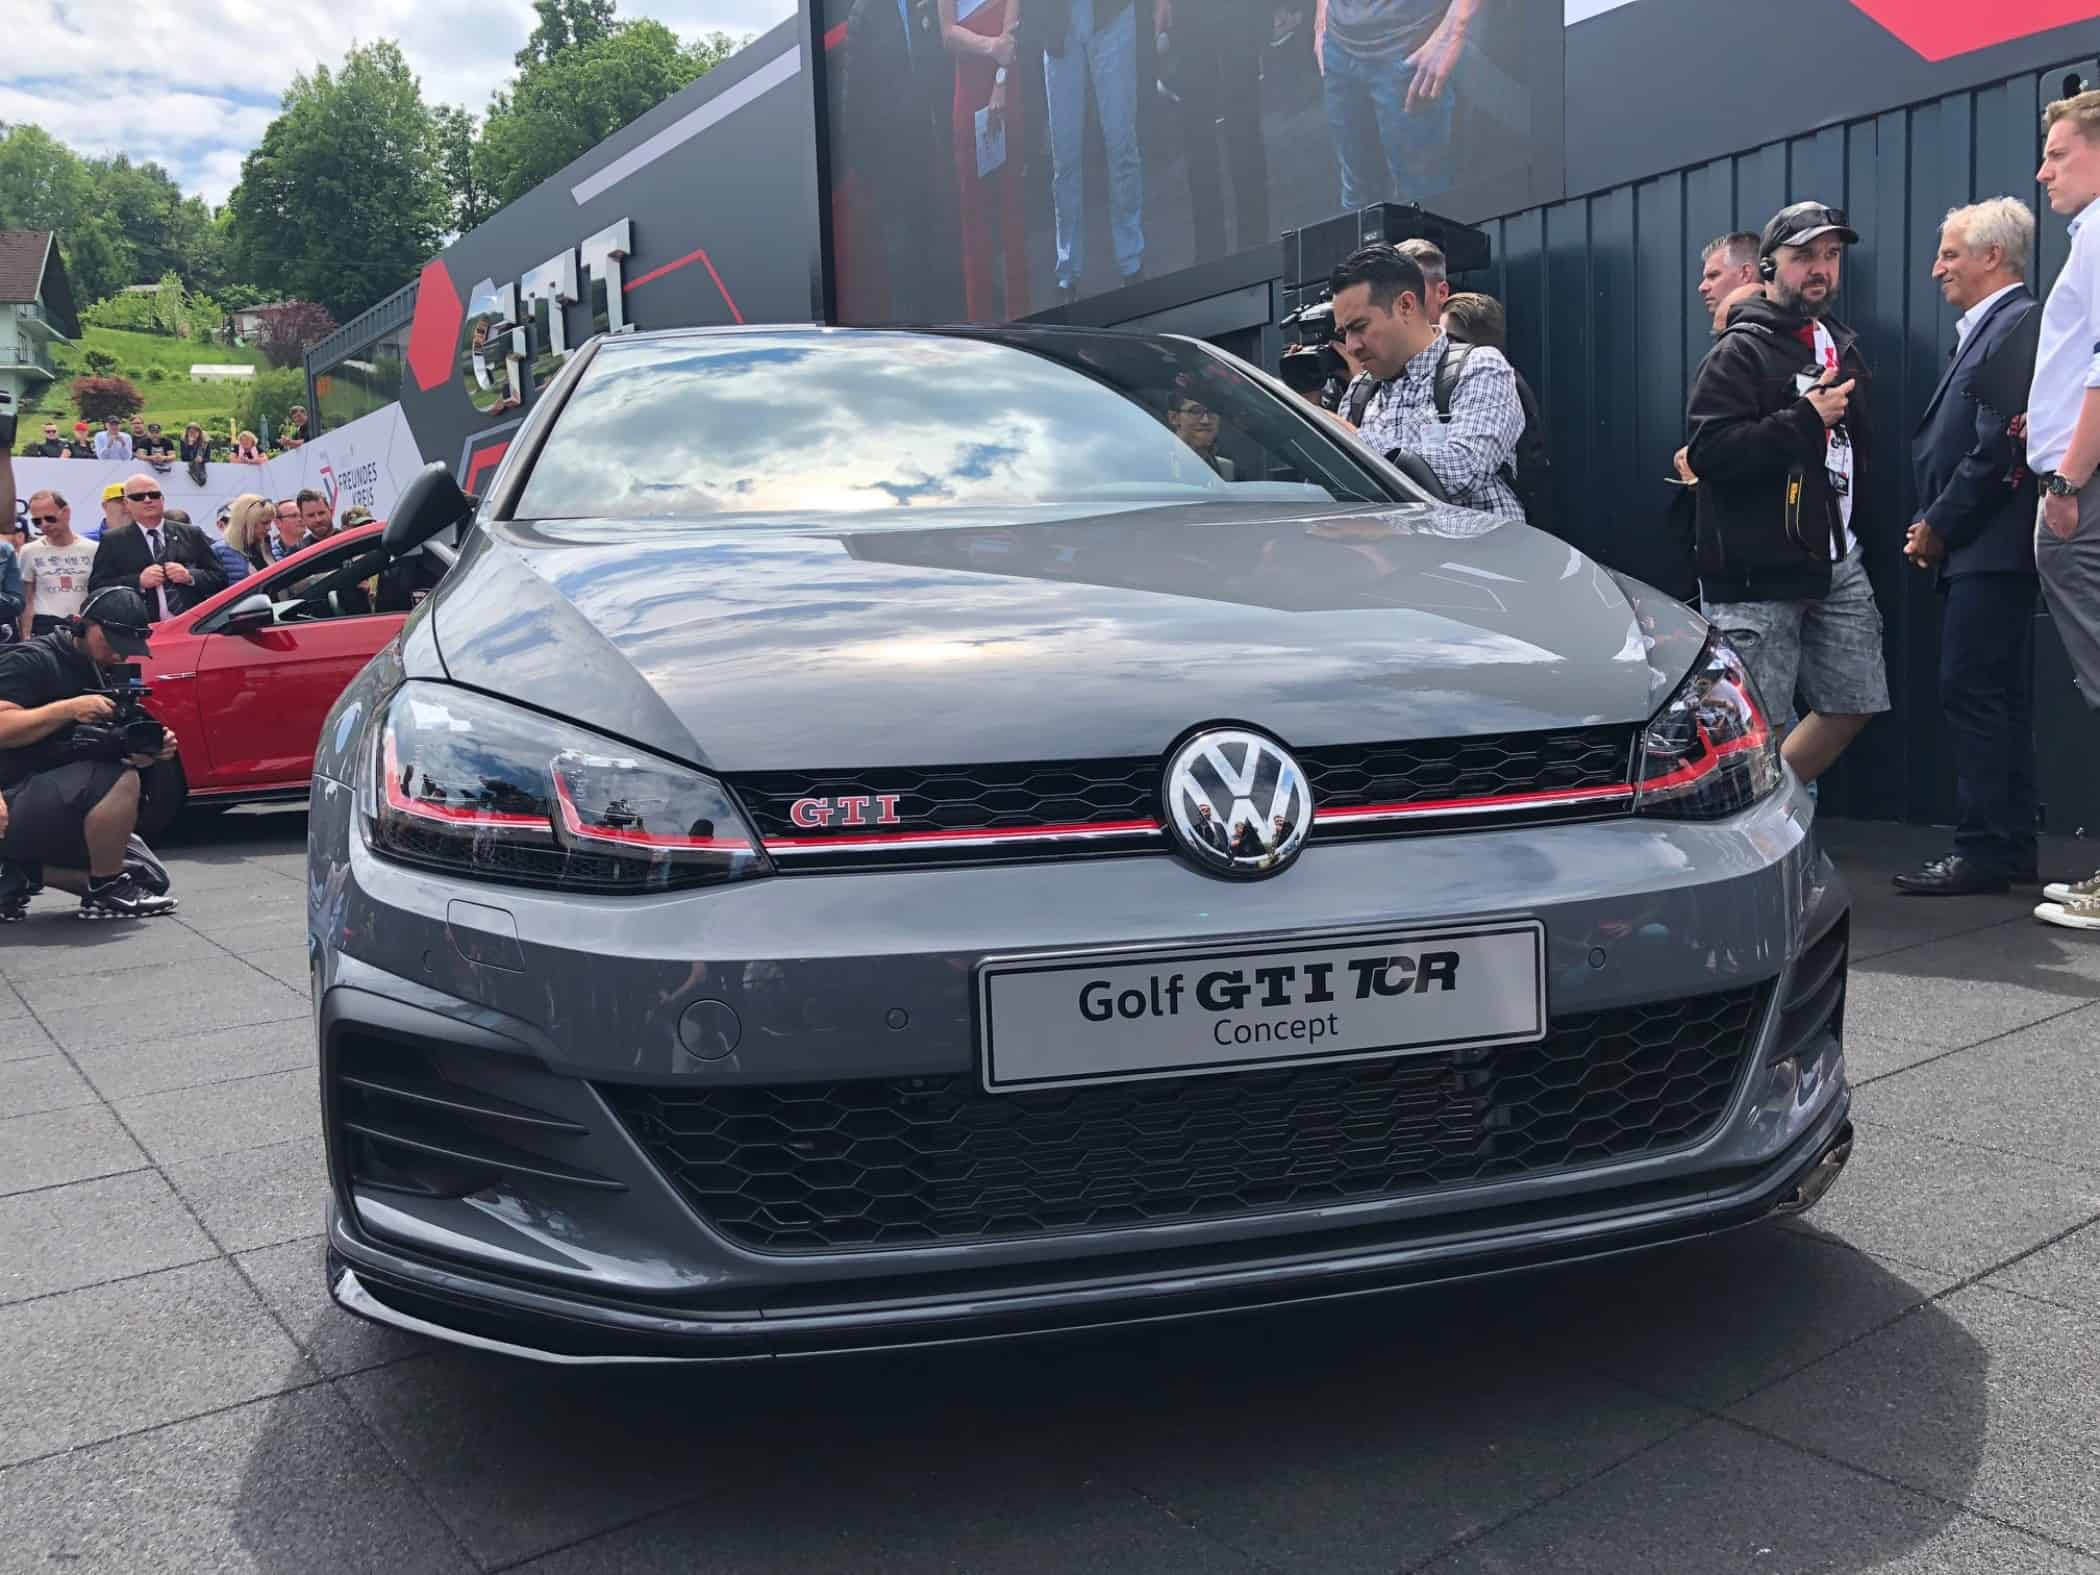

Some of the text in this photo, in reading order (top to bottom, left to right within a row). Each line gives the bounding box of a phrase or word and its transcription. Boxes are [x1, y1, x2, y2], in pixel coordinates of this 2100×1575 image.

[463, 217, 634, 414] GTI
[338, 461, 377, 490] FREUNDES
[352, 486, 374, 507] KREIS
[790, 795, 900, 827] GTI
[1078, 951, 1459, 1021] Golf GTI TCR
[1213, 1012, 1339, 1045] Concept
